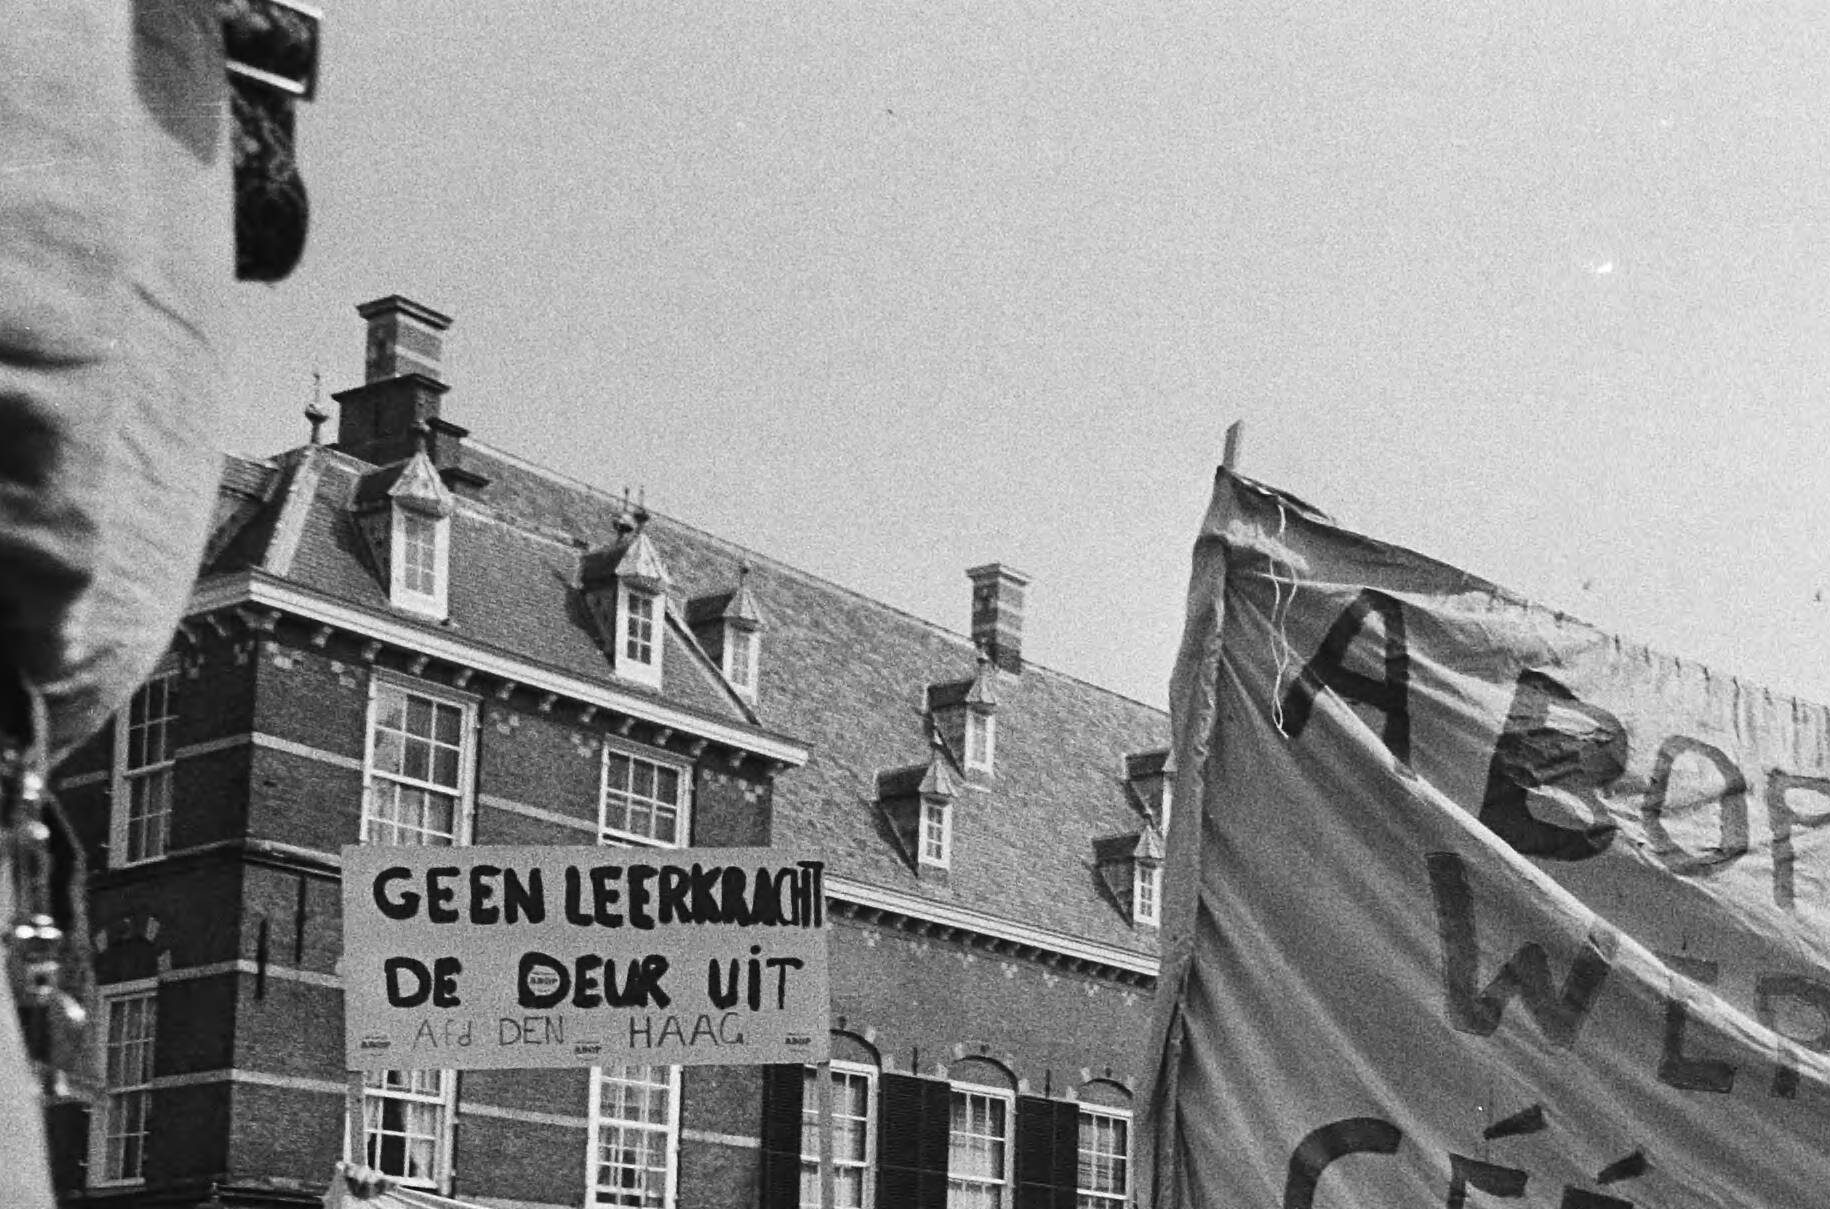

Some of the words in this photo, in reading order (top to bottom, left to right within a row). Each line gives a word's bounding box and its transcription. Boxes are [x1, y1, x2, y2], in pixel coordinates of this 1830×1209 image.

[373, 864, 546, 925] GEEN
[563, 860, 825, 930] LEERKRACHT
[384, 957, 462, 1008] DE
[517, 951, 671, 1010] DEUR
[500, 1014, 565, 1047] DEN
[629, 1011, 743, 1049] HAAG
